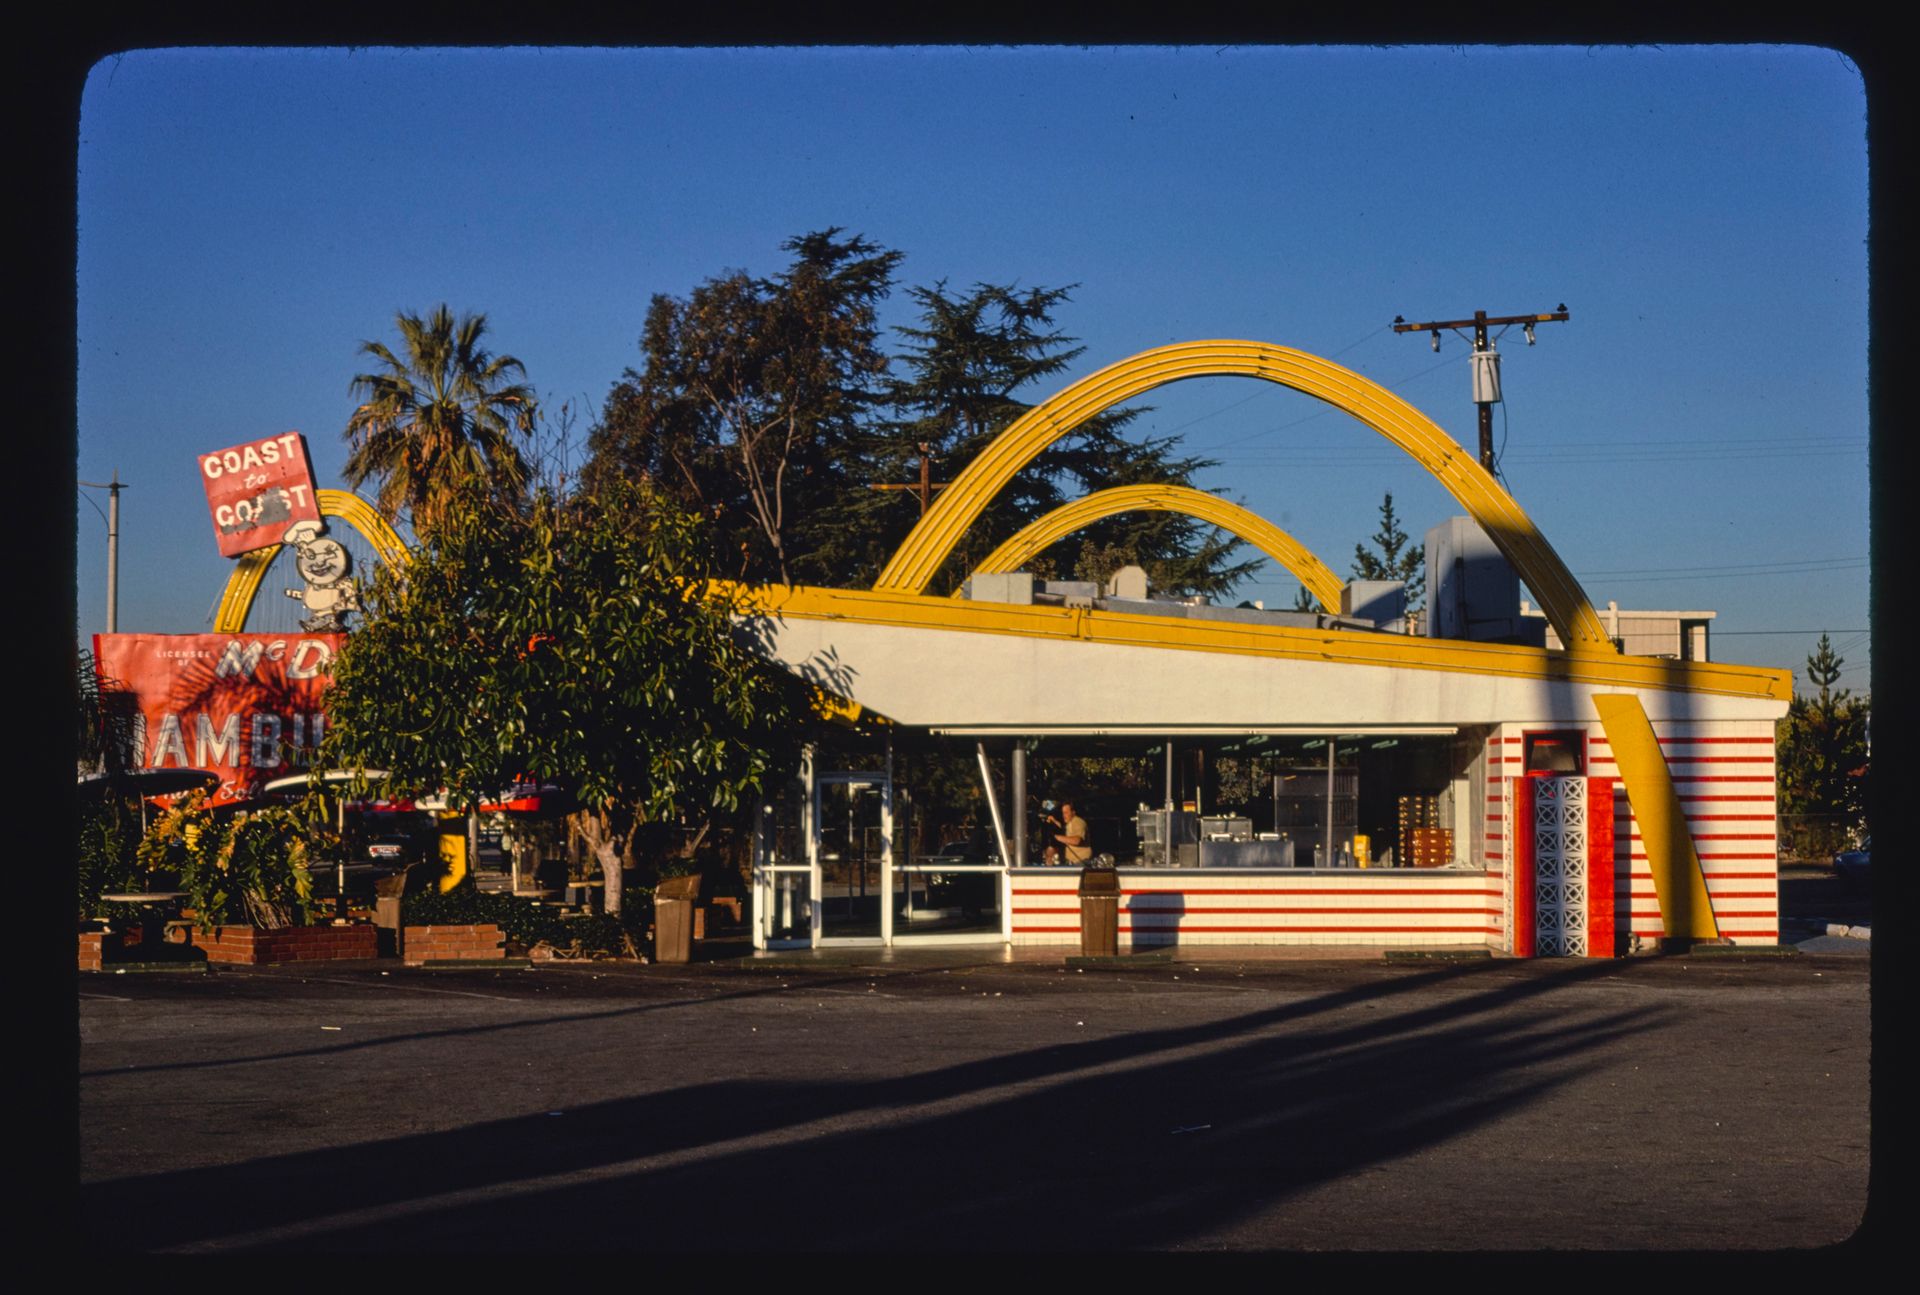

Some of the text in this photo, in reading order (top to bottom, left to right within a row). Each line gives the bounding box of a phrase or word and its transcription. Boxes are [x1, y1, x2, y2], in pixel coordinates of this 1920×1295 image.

[204, 435, 295, 478] COAST
[244, 472, 270, 489] to
[157, 650, 211, 658] LICENSEE
